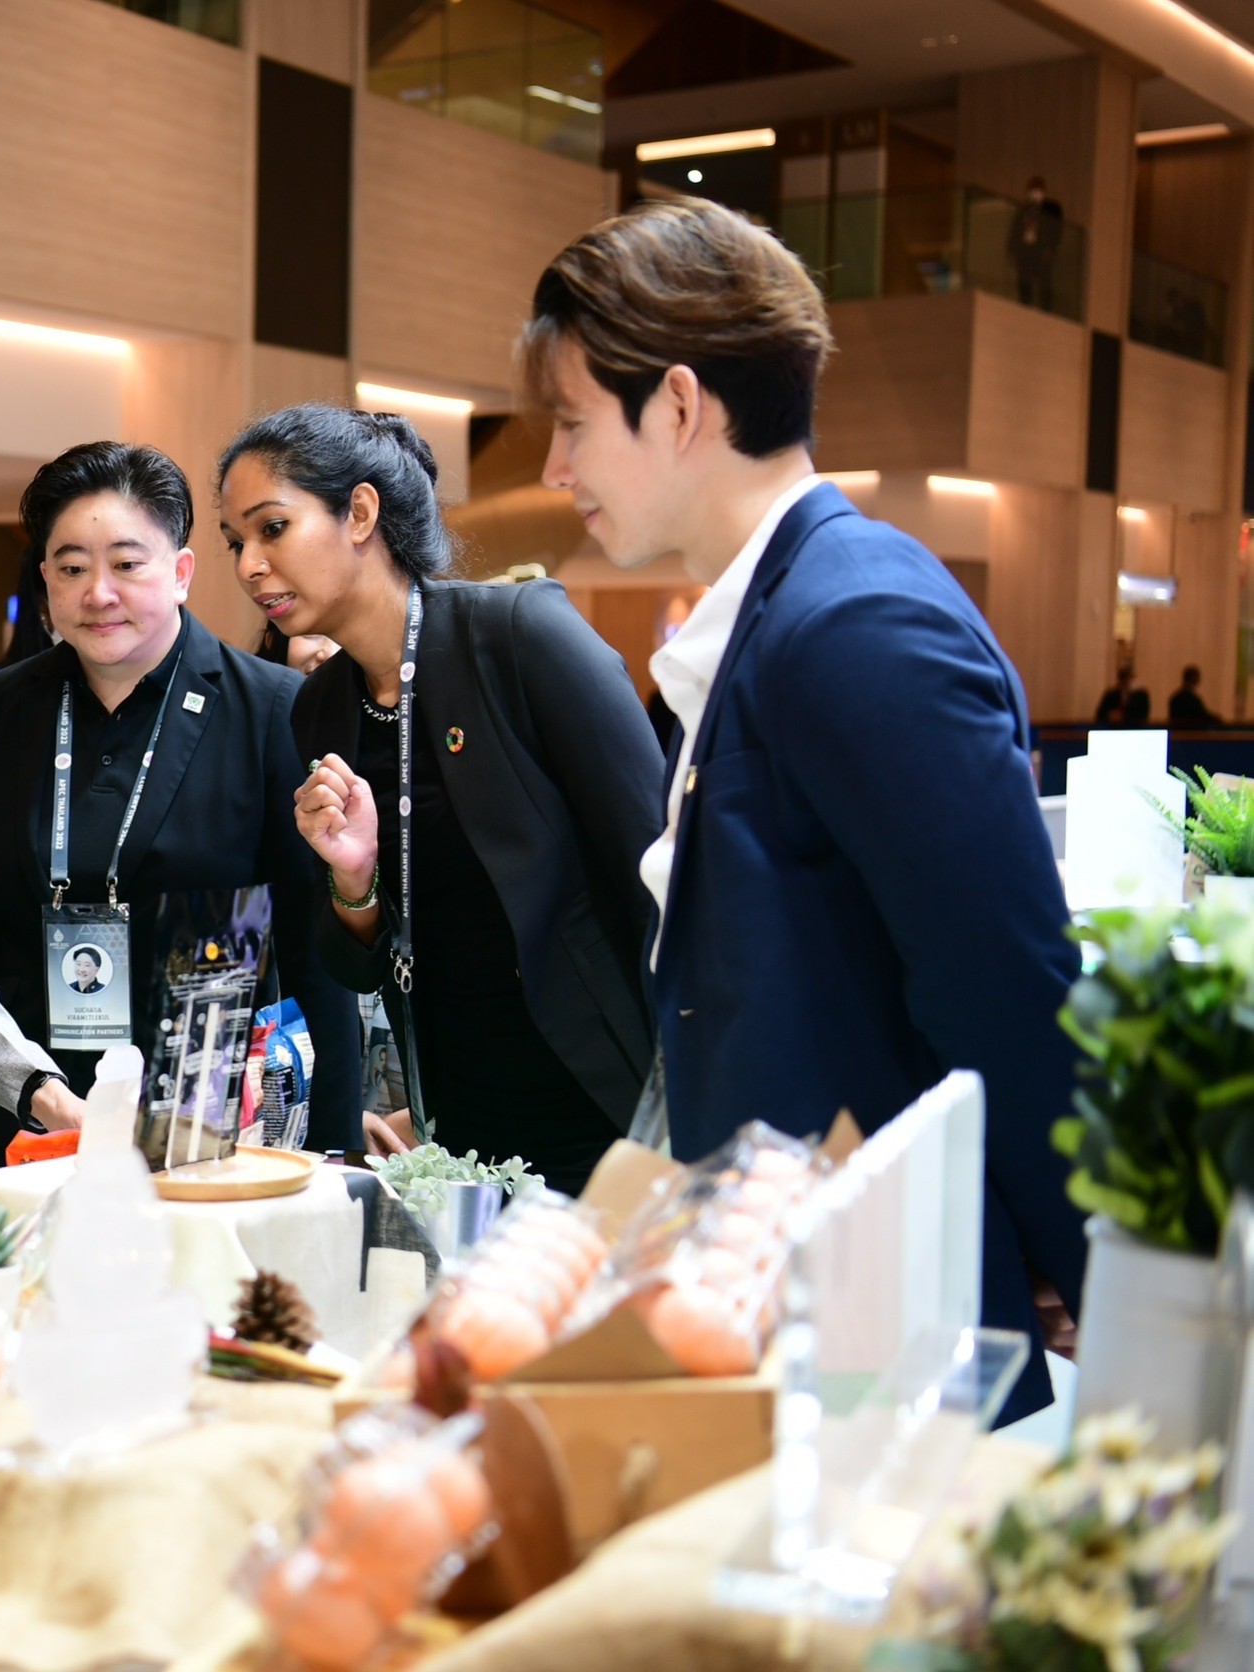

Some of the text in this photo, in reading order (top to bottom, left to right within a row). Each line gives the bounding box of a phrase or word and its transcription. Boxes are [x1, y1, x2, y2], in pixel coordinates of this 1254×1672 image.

[407, 628, 418, 651] APEC
[61, 693, 70, 727] THAILAND
[60, 727, 68, 745] 2022
[401, 694, 409, 784] APEC THAILAND 2022
[55, 778, 66, 850] APEC THAILAND 2022
[401, 828, 409, 850] 2022
